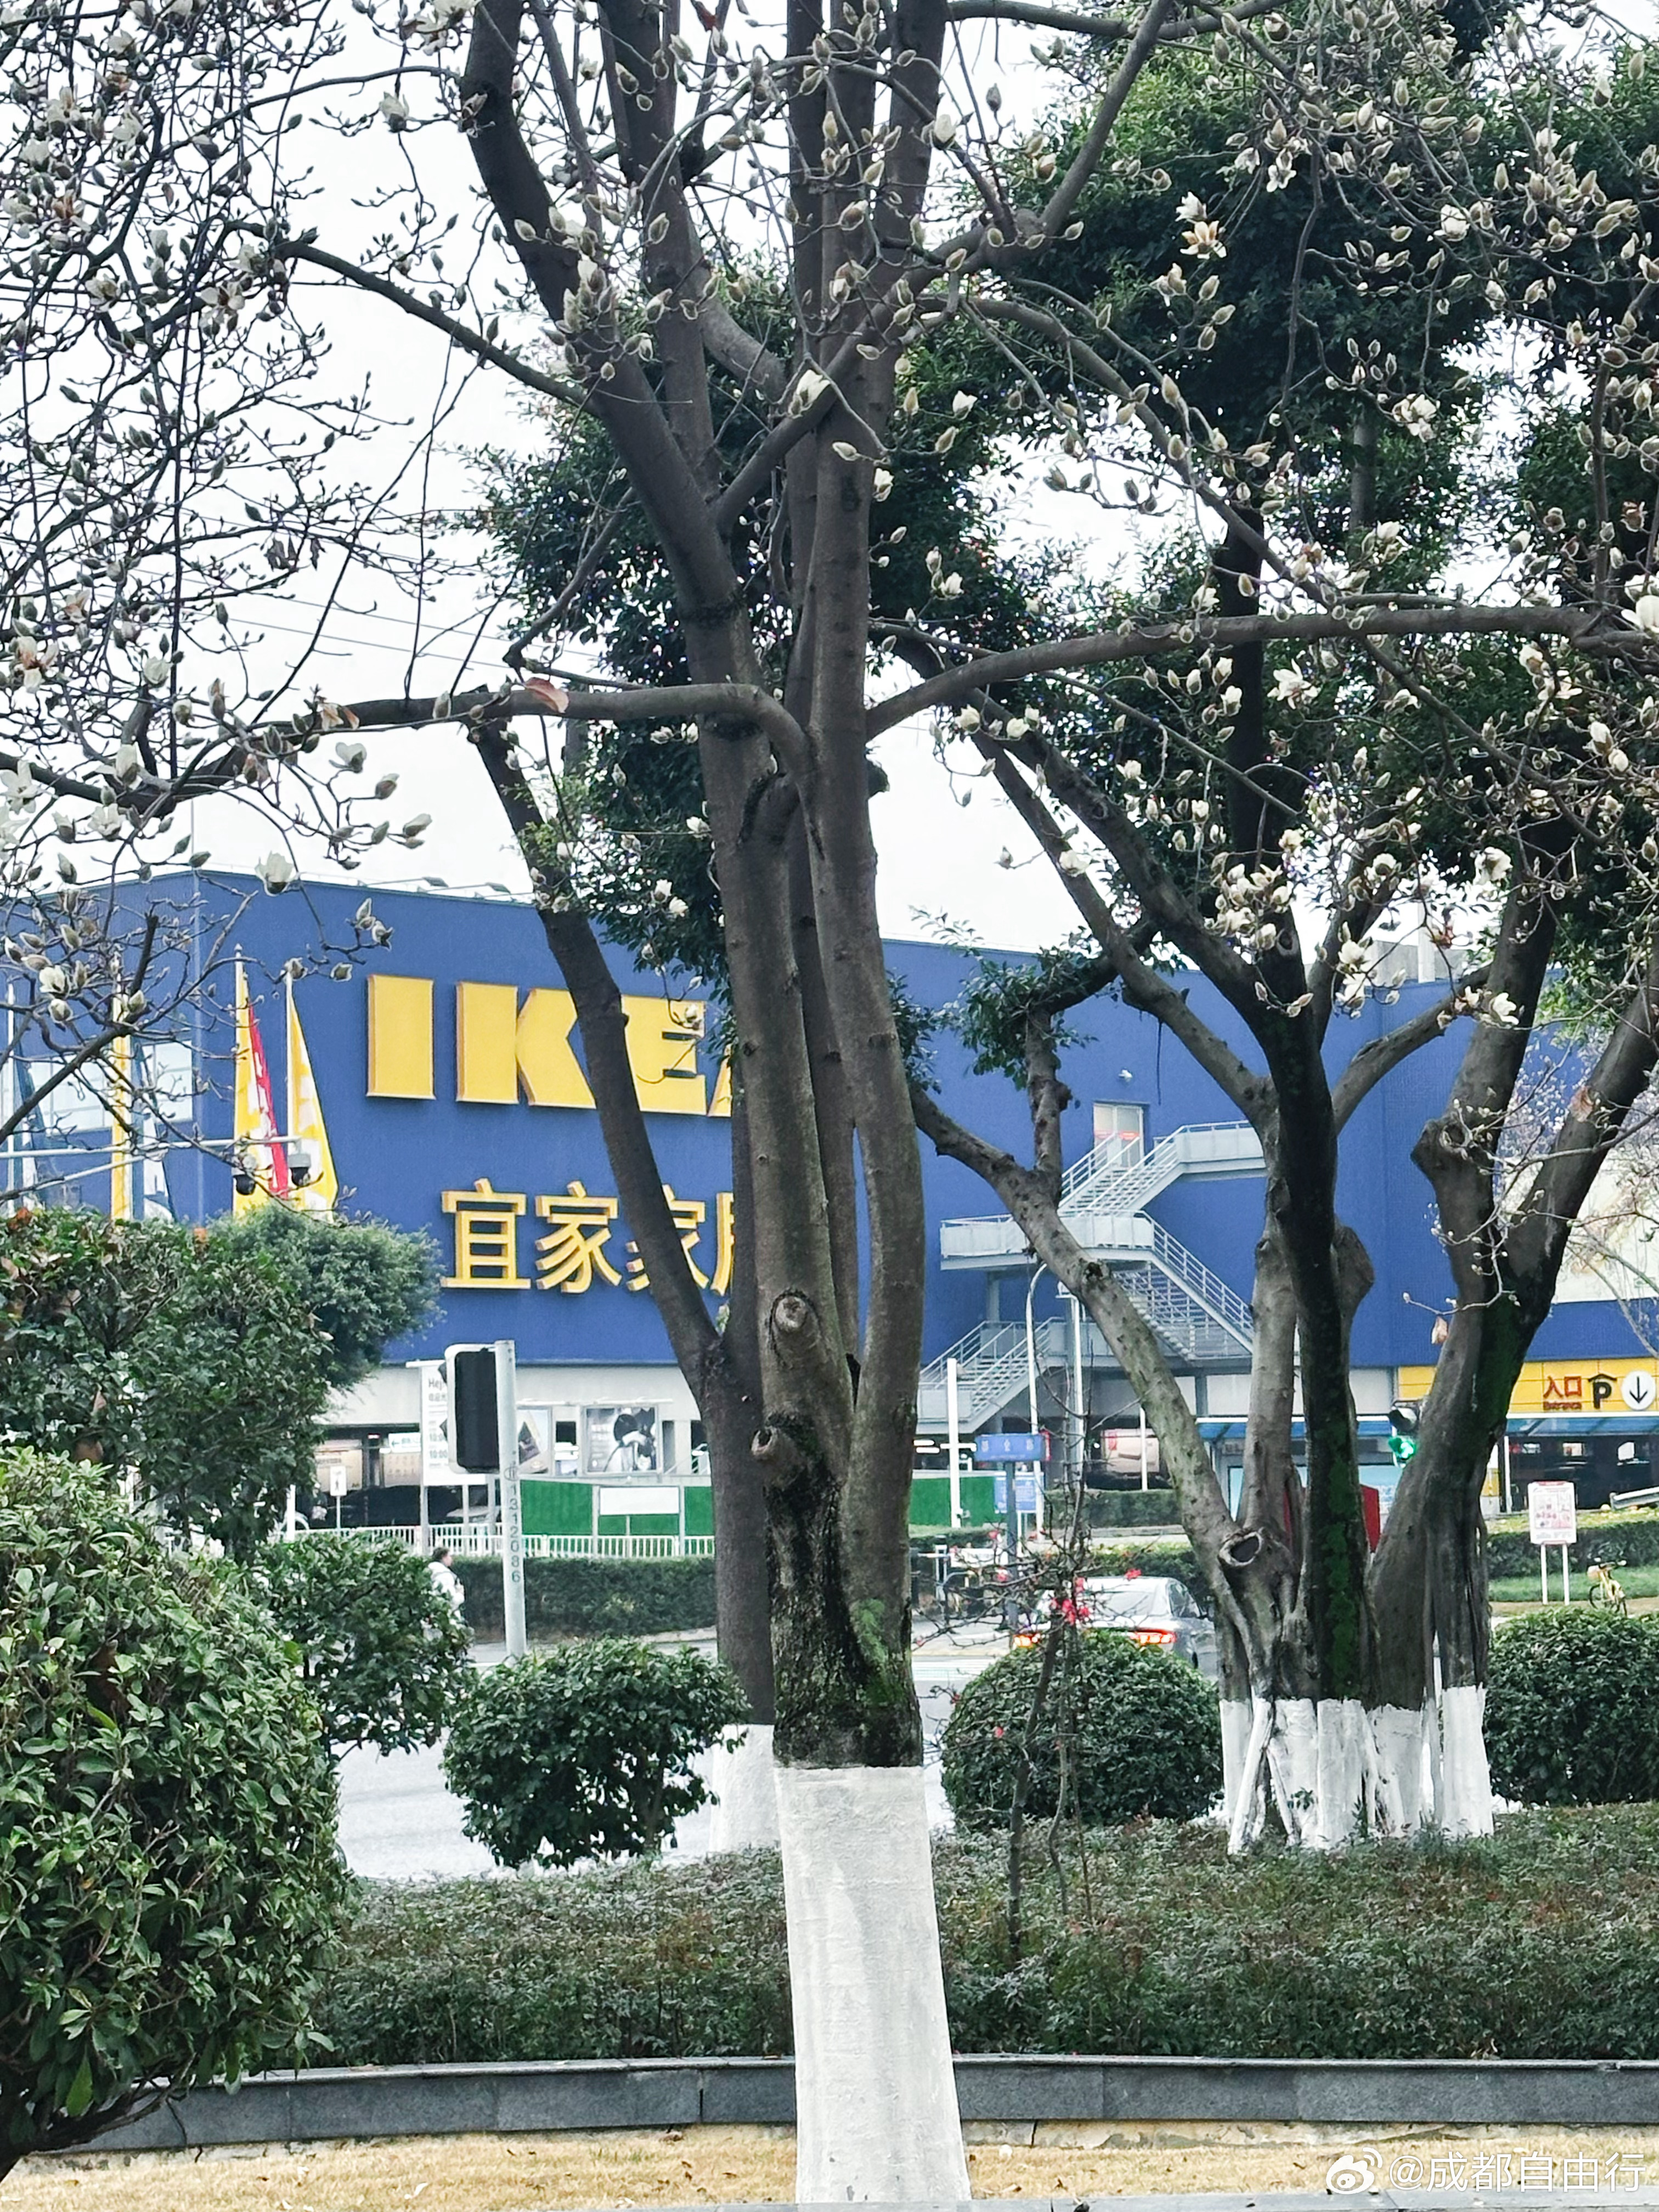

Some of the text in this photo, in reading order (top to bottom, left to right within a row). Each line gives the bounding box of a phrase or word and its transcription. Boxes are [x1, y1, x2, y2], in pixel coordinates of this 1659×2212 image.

[366, 974, 731, 1117] IKE
[441, 1178, 734, 1296] 宜家家
[1543, 1376, 1582, 1398] 入口
